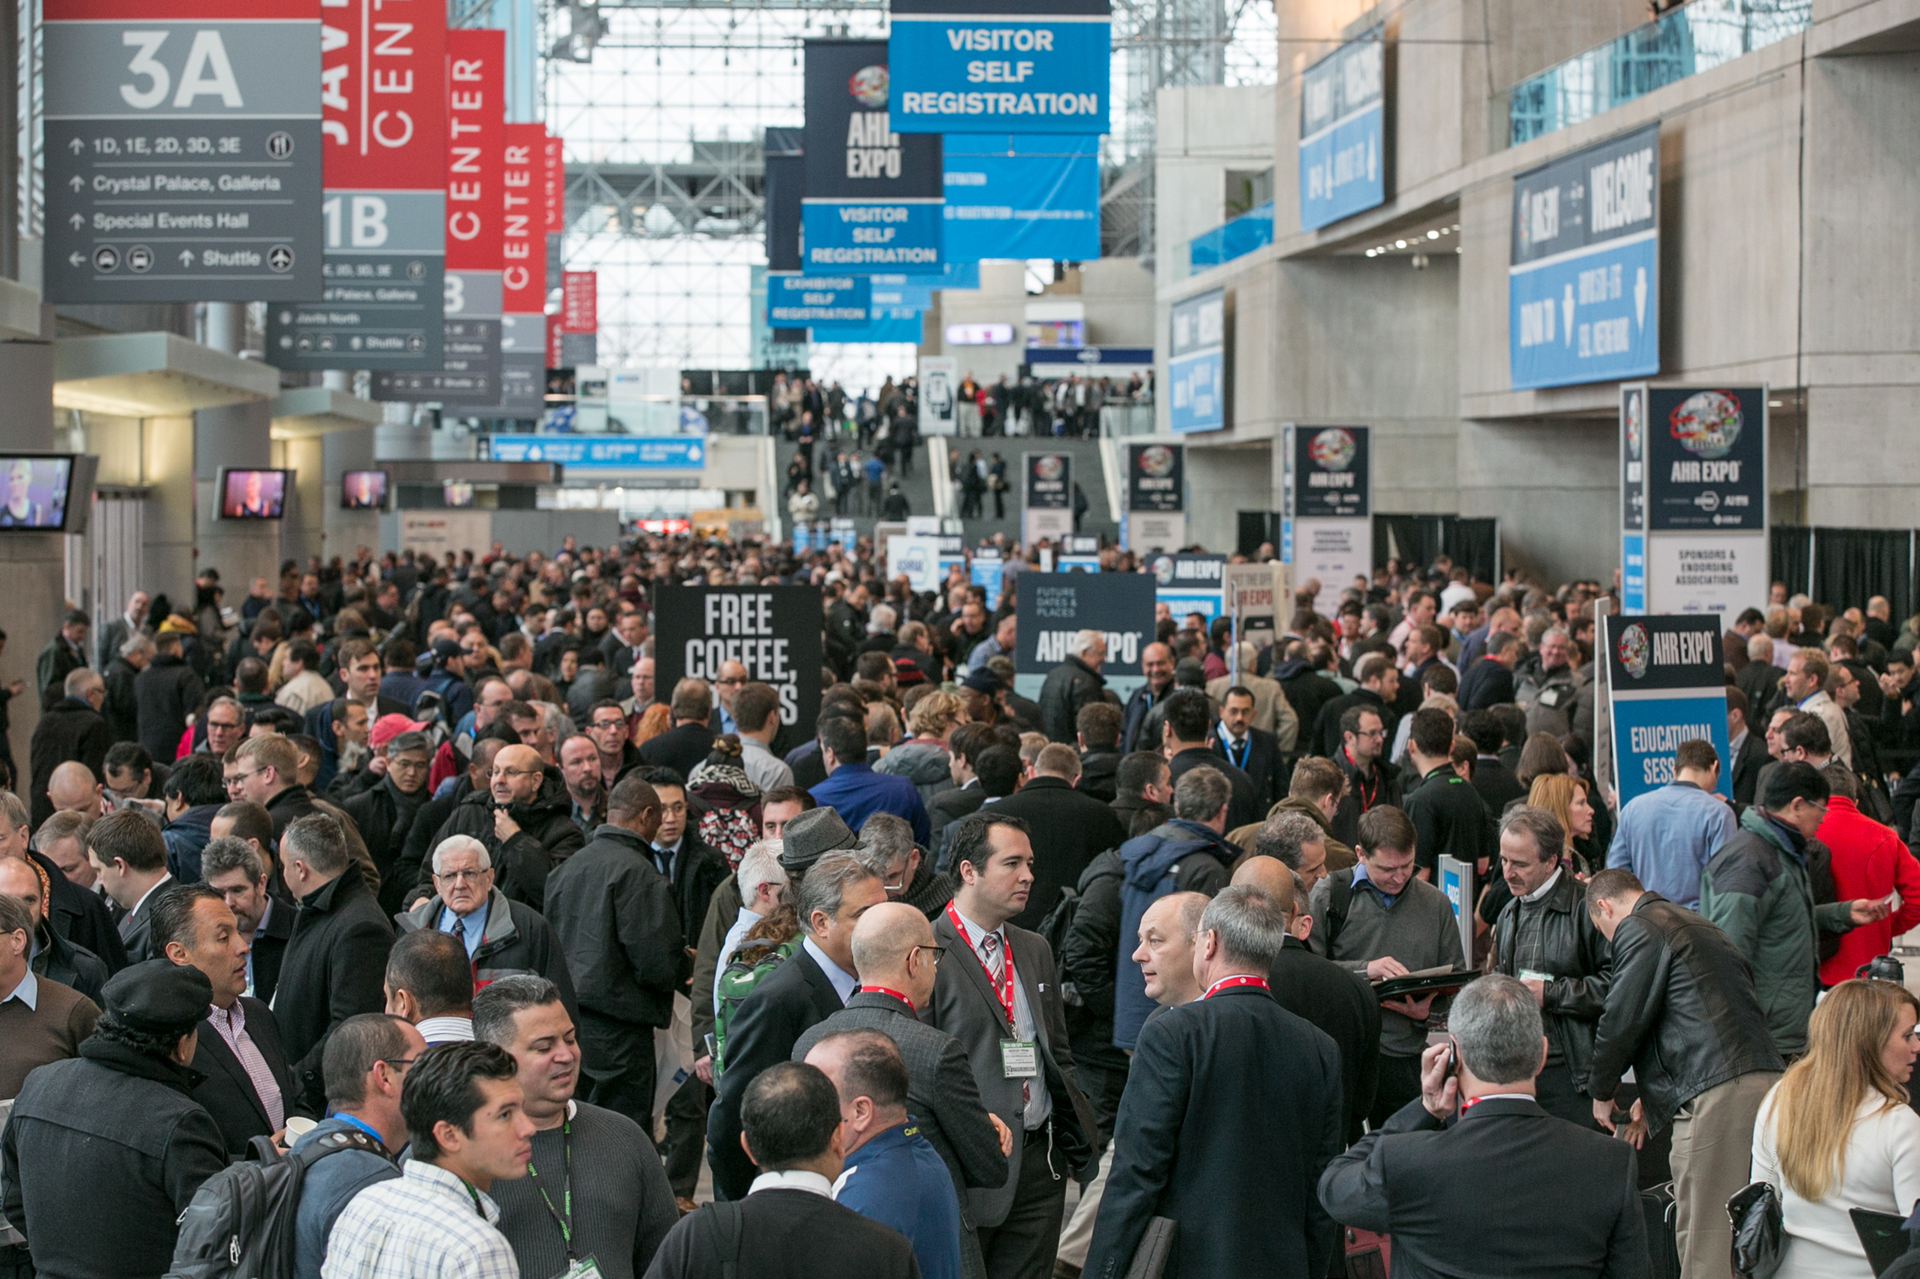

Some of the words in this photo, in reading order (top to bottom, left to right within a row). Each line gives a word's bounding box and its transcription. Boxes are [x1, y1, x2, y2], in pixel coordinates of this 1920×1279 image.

[947, 28, 1054, 51] VISITOR
[119, 30, 244, 109] 3A
[967, 60, 1034, 83] SELF
[902, 91, 1098, 115] REGISTRATION
[94, 137, 121, 155] 1D,
[125, 137, 151, 155] 1E,
[154, 137, 183, 155] 2D,
[187, 137, 215, 155] 3D,
[218, 137, 241, 153] 3E
[450, 60, 483, 240] CENTER
[846, 148, 901, 178] EXPO
[93, 175, 150, 194] Crystal
[154, 175, 214, 192] Palace,
[218, 174, 281, 191] Galleria
[1591, 147, 1653, 234] WELCOME
[93, 213, 153, 232] Special
[157, 212, 213, 229] Events
[217, 212, 249, 228] Hall
[323, 196, 388, 247] 1B
[503, 145, 530, 290] CENTER
[839, 207, 908, 223] VISITOR
[852, 227, 895, 243] SELF
[202, 250, 261, 267] Shuttle
[811, 247, 937, 264] REGISTRATION
[784, 278, 854, 290] EXHIBITOR
[802, 292, 835, 305] SELF
[329, 312, 360, 325] North
[772, 307, 866, 320] REGISTRATION
[366, 337, 404, 349] Shuttle
[1671, 461, 1701, 483] AHR
[1702, 461, 1739, 483] EXPO
[1678, 550, 1727, 560] SPONSORS
[1729, 550, 1736, 560] &
[1175, 560, 1195, 579] AHR
[1195, 560, 1221, 579] EXPO
[1680, 563, 1733, 573] ENDORSING
[1675, 575, 1739, 585] ASSOCIATIONS
[1036, 587, 1075, 596] FUTURE
[1036, 598, 1066, 607] DATES
[705, 594, 773, 635] FREE
[1036, 608, 1076, 618] PLACES
[1653, 632, 1680, 665] AHR
[1679, 631, 1714, 665] EXPO
[685, 639, 797, 683] COFFEE,
[1643, 757, 1675, 784] SESS
